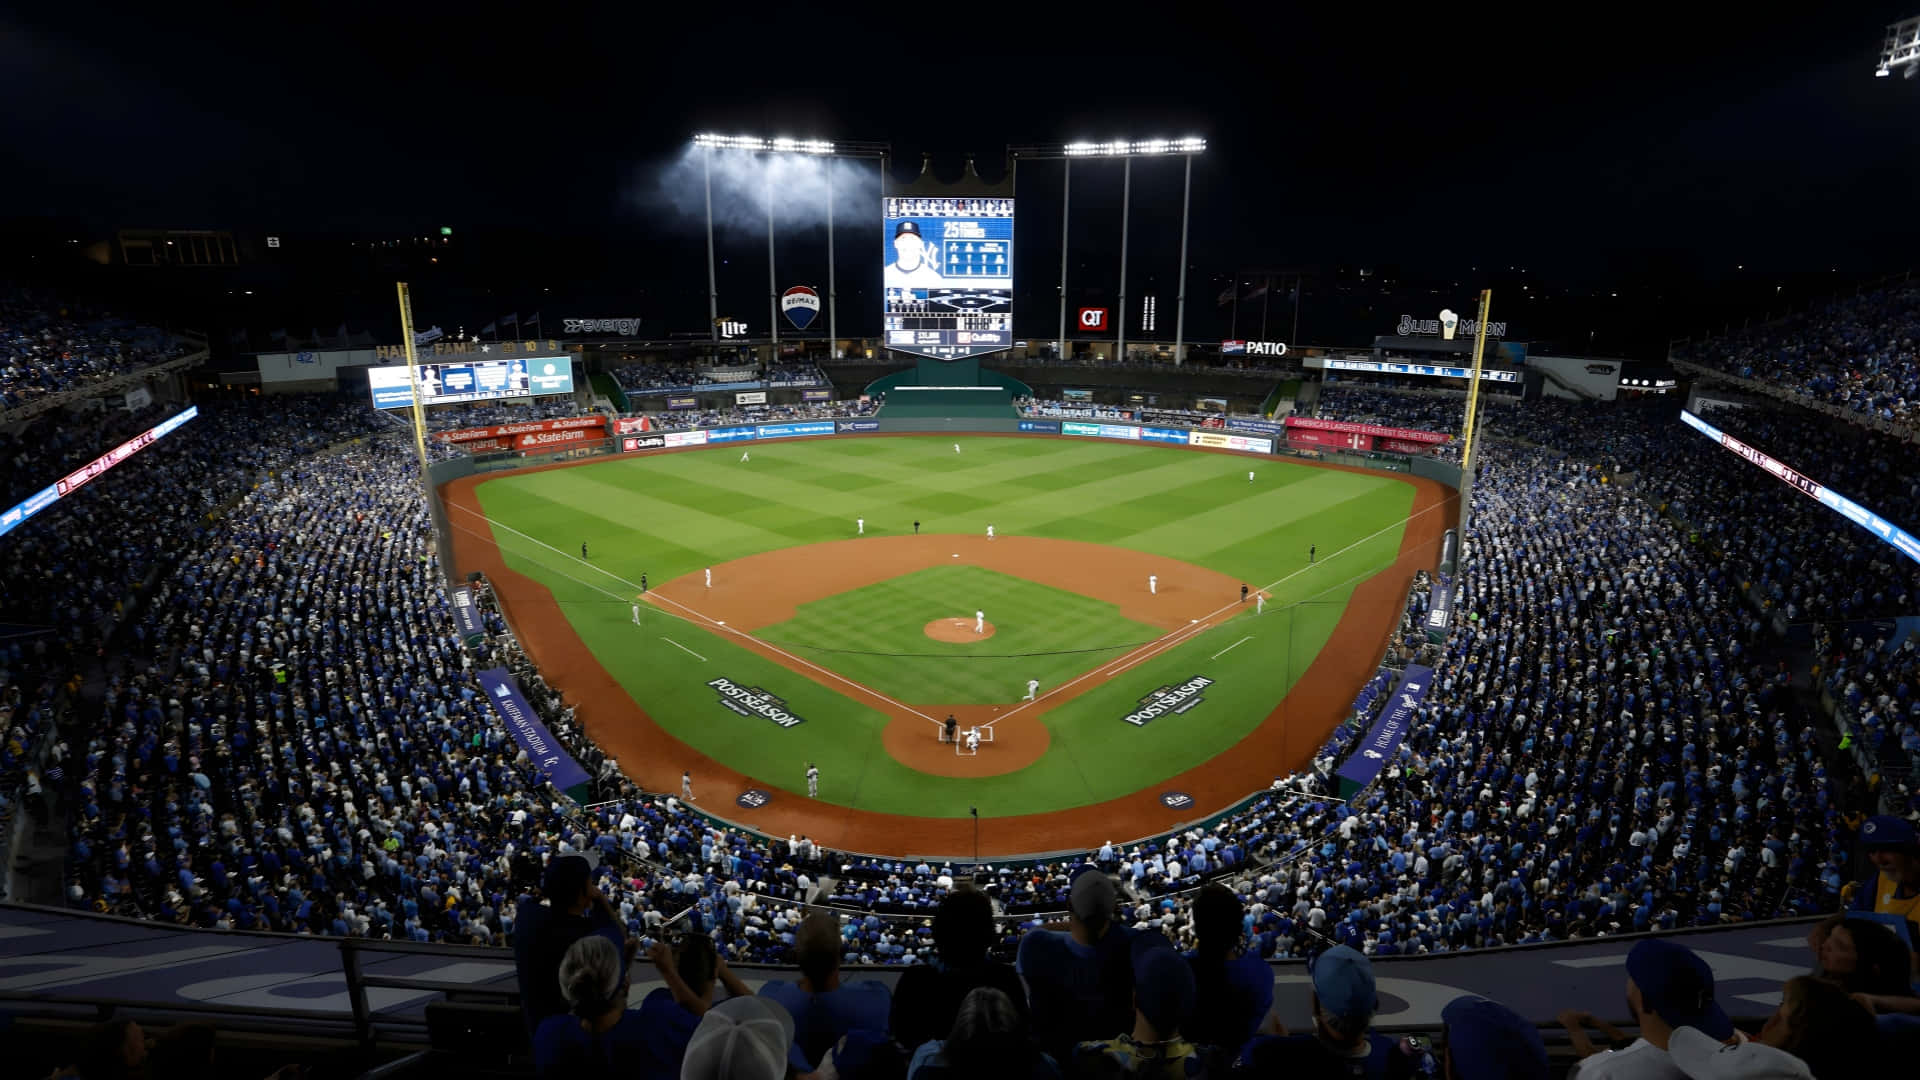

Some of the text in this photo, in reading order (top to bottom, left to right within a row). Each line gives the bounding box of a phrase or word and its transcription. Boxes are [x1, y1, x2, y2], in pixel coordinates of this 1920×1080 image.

[944, 222, 959, 238] 25
[582, 318, 640, 335] evergy
[1081, 310, 1103, 326] QT
[721, 321, 748, 338] Lite
[434, 341, 476, 355] FAME
[1247, 341, 1287, 355] PATIO
[1294, 419, 1330, 430] AMERICA'S
[1330, 422, 1361, 433] LARGEST
[1367, 426, 1396, 436] FASTEST
[1408, 431, 1444, 441] NETWORK
[708, 678, 801, 727] POSTSEASON
[1125, 677, 1213, 725] POSTSEASON
[502, 698, 527, 729] KAUFFMAN
[523, 726, 549, 756] STADIUM
[1374, 708, 1407, 749] HOME OF THE
